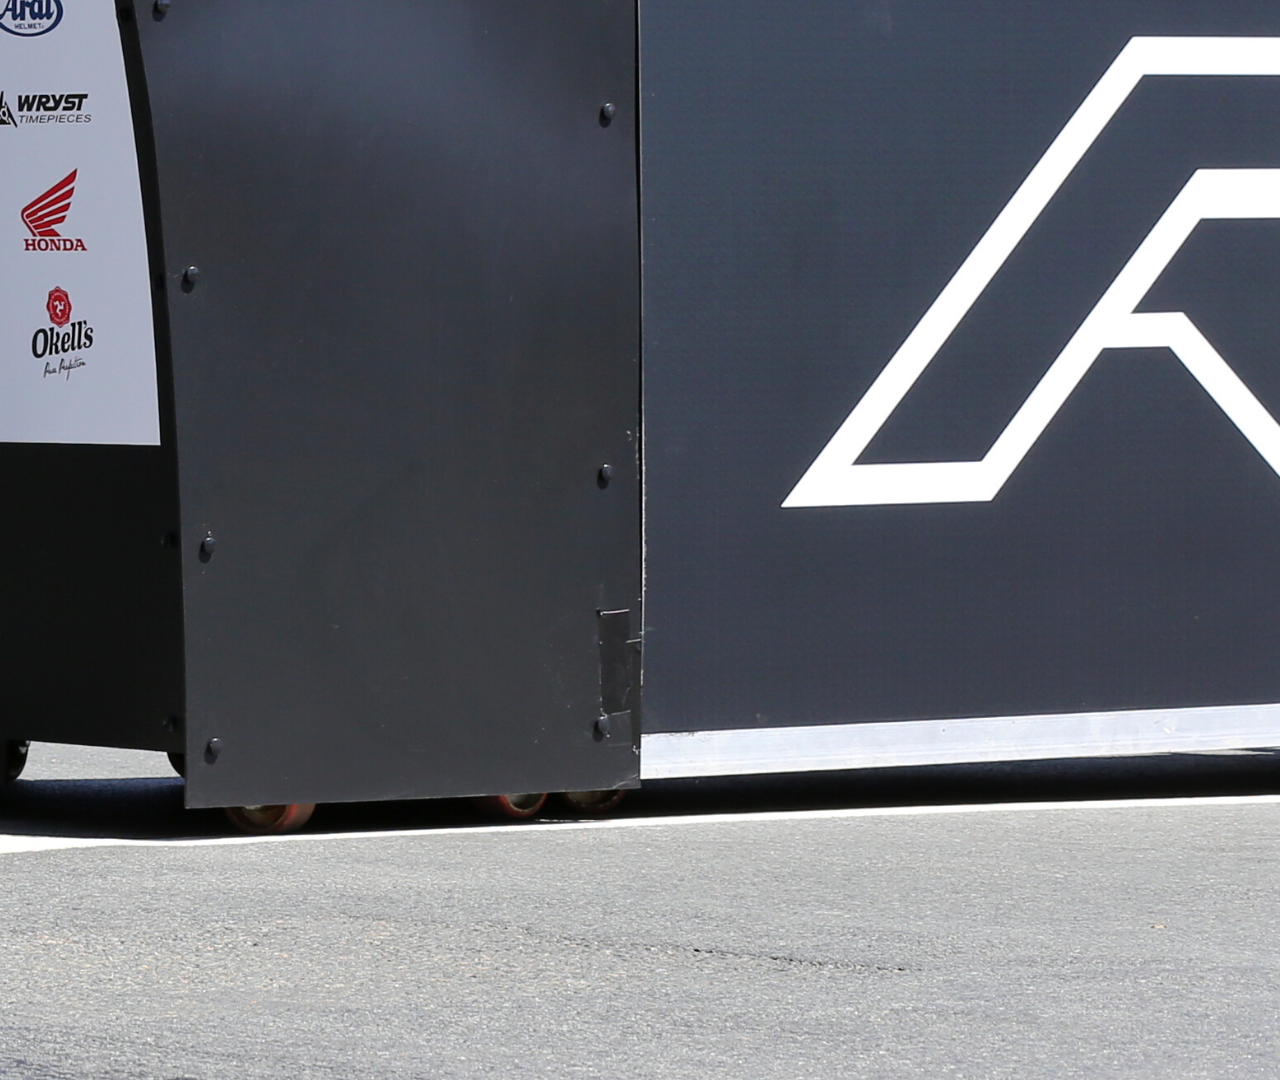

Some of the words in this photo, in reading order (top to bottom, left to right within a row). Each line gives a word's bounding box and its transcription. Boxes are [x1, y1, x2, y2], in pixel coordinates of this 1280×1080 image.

[17, 94, 89, 112] WRYST
[18, 114, 92, 124] TIMEPIECES
[24, 239, 88, 251] HONDA
[31, 320, 93, 358] Okell's
